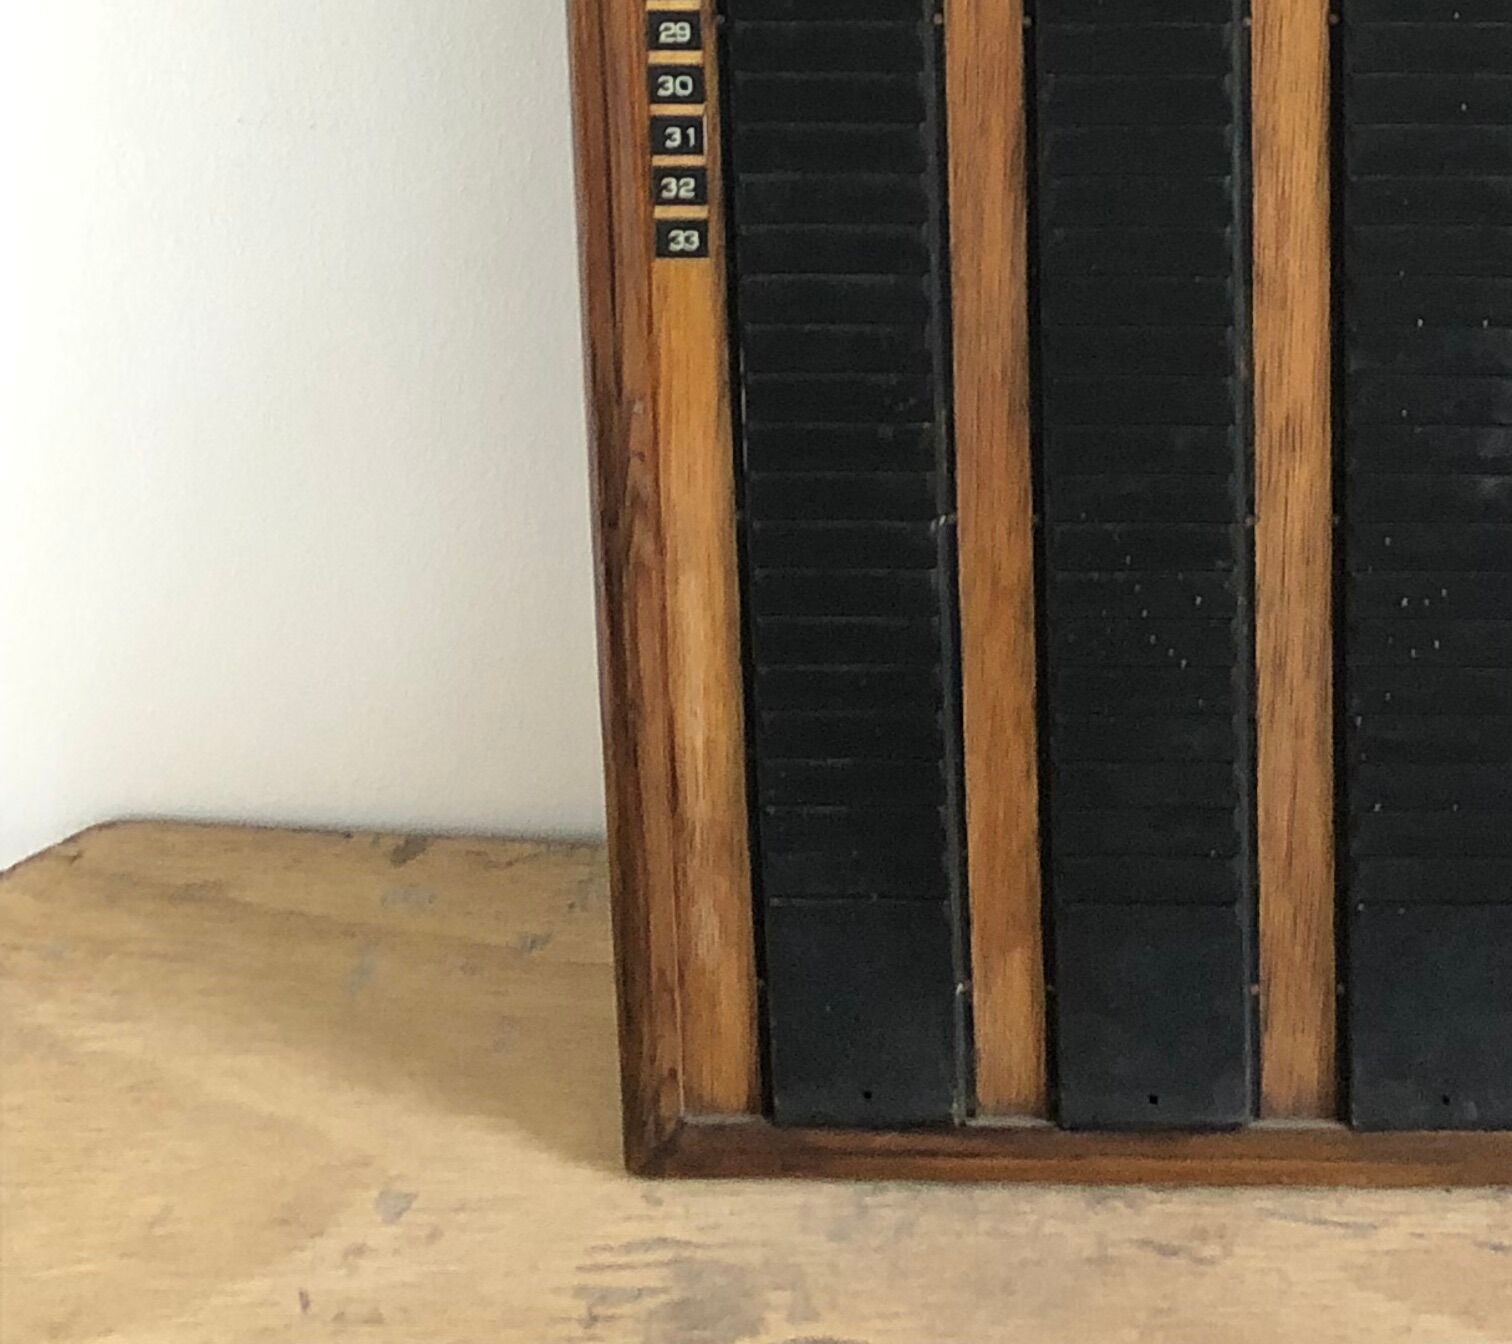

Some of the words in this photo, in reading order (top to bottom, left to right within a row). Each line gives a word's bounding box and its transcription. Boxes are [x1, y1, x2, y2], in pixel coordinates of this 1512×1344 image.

[658, 20, 692, 44] 29
[656, 74, 694, 98] 30
[664, 125, 696, 149] 31
[660, 176, 696, 199] 32
[668, 229, 701, 252] 33
